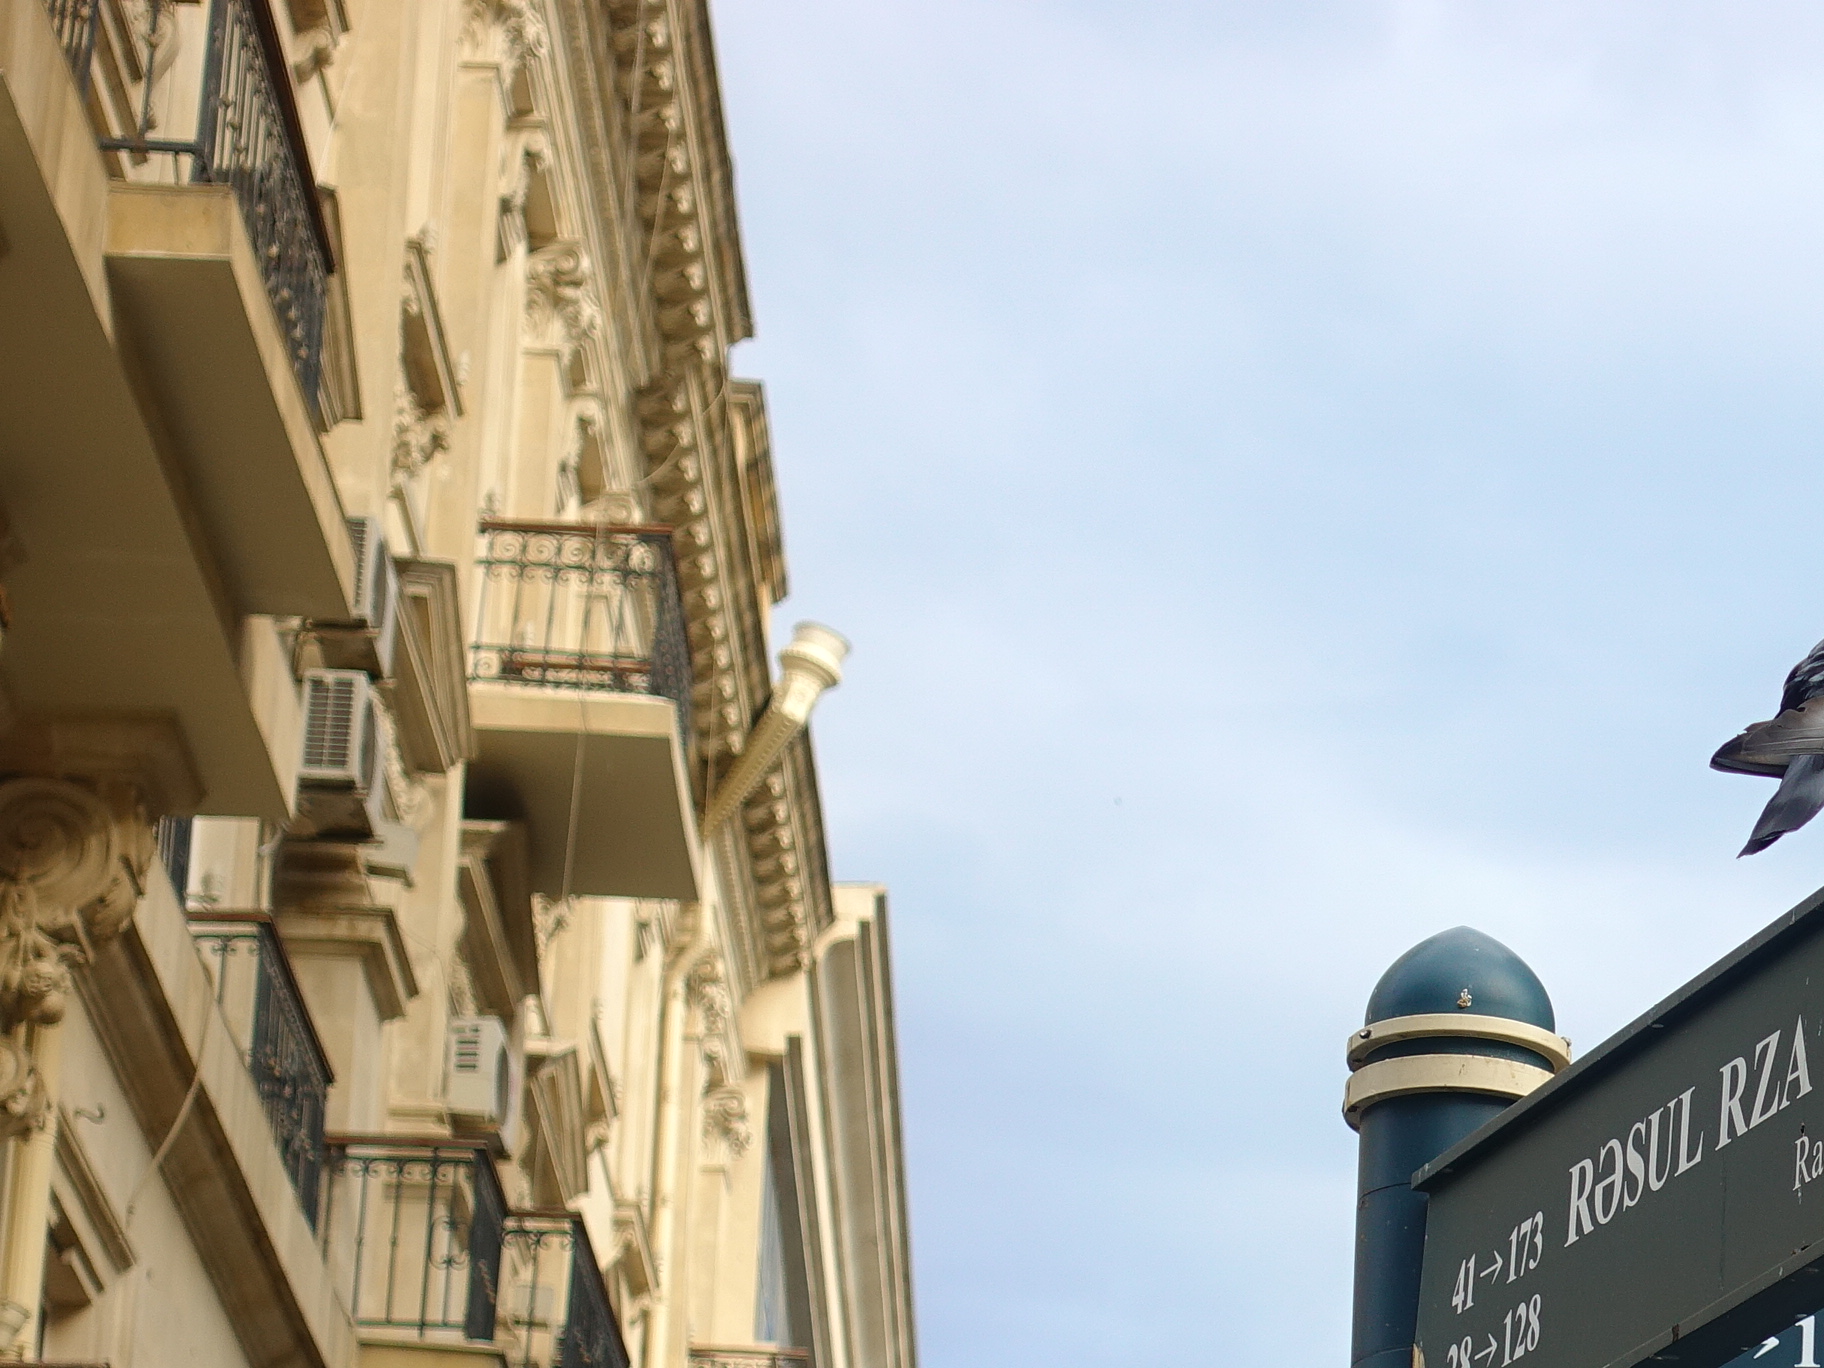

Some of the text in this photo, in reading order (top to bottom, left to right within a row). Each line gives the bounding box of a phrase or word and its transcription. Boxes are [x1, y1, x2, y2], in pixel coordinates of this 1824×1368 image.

[1563, 1086, 1705, 1249] RƏSUL
[1714, 1014, 1813, 1153] RZA
[1451, 1210, 1545, 1316] 41 173
[1500, 1293, 1543, 1368] 128
[1793, 1314, 1821, 1368] 1
